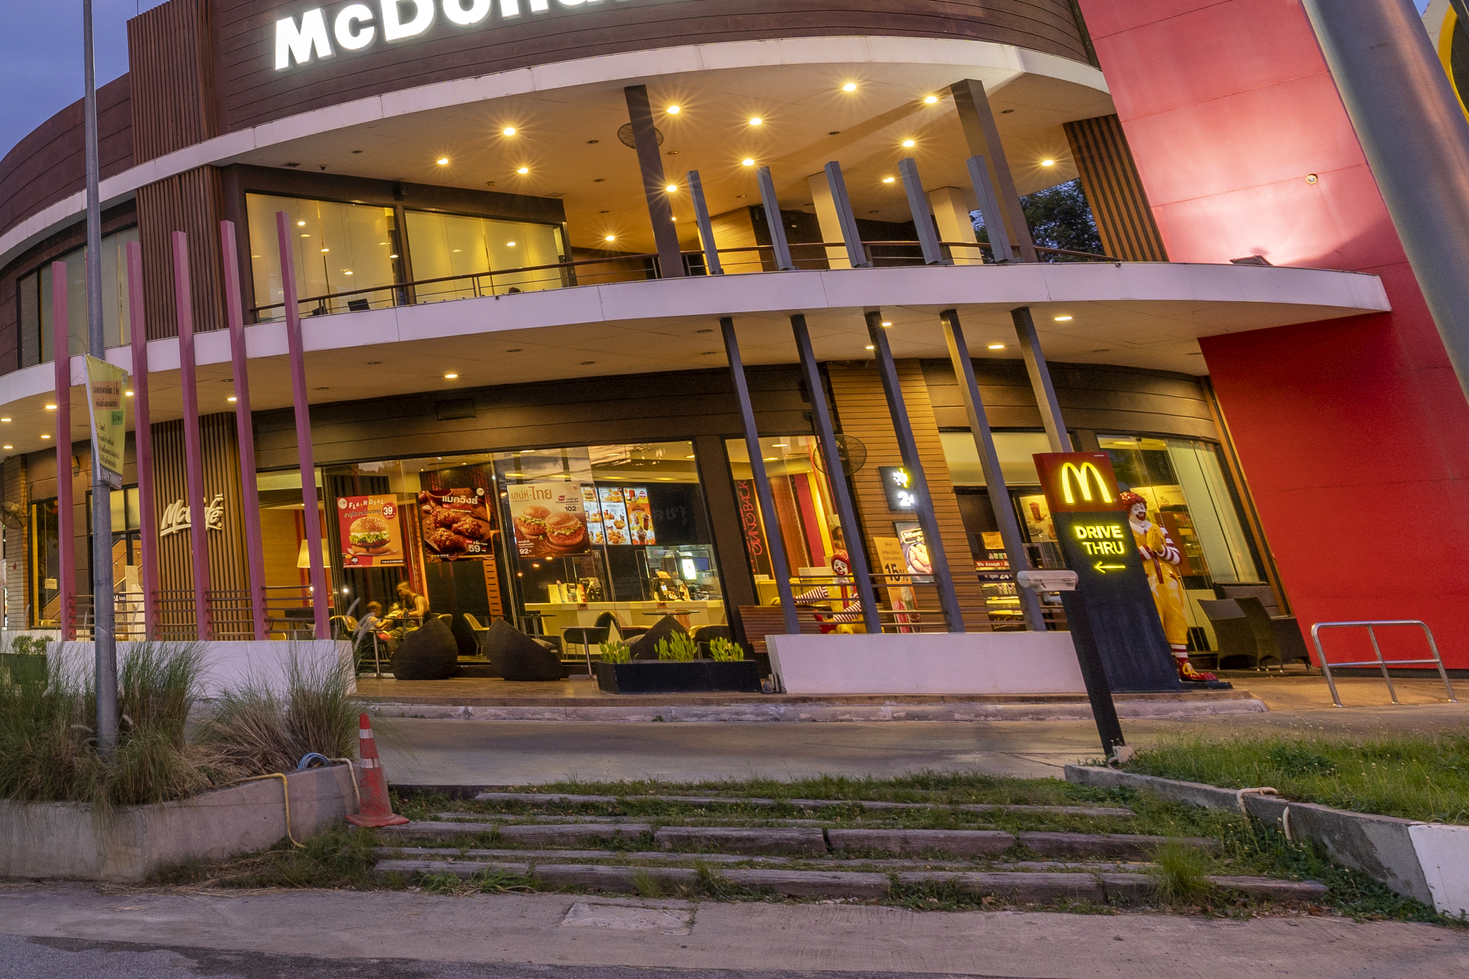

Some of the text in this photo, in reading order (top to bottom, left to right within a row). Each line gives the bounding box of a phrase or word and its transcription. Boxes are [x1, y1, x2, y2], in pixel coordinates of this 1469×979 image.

[737, 480, 754, 512] BACK
[160, 493, 224, 534] Mcfé
[383, 506, 393, 515] 39
[1073, 524, 1124, 539] DRIVE
[468, 544, 481, 553] 59
[1082, 540, 1126, 555] THRU
